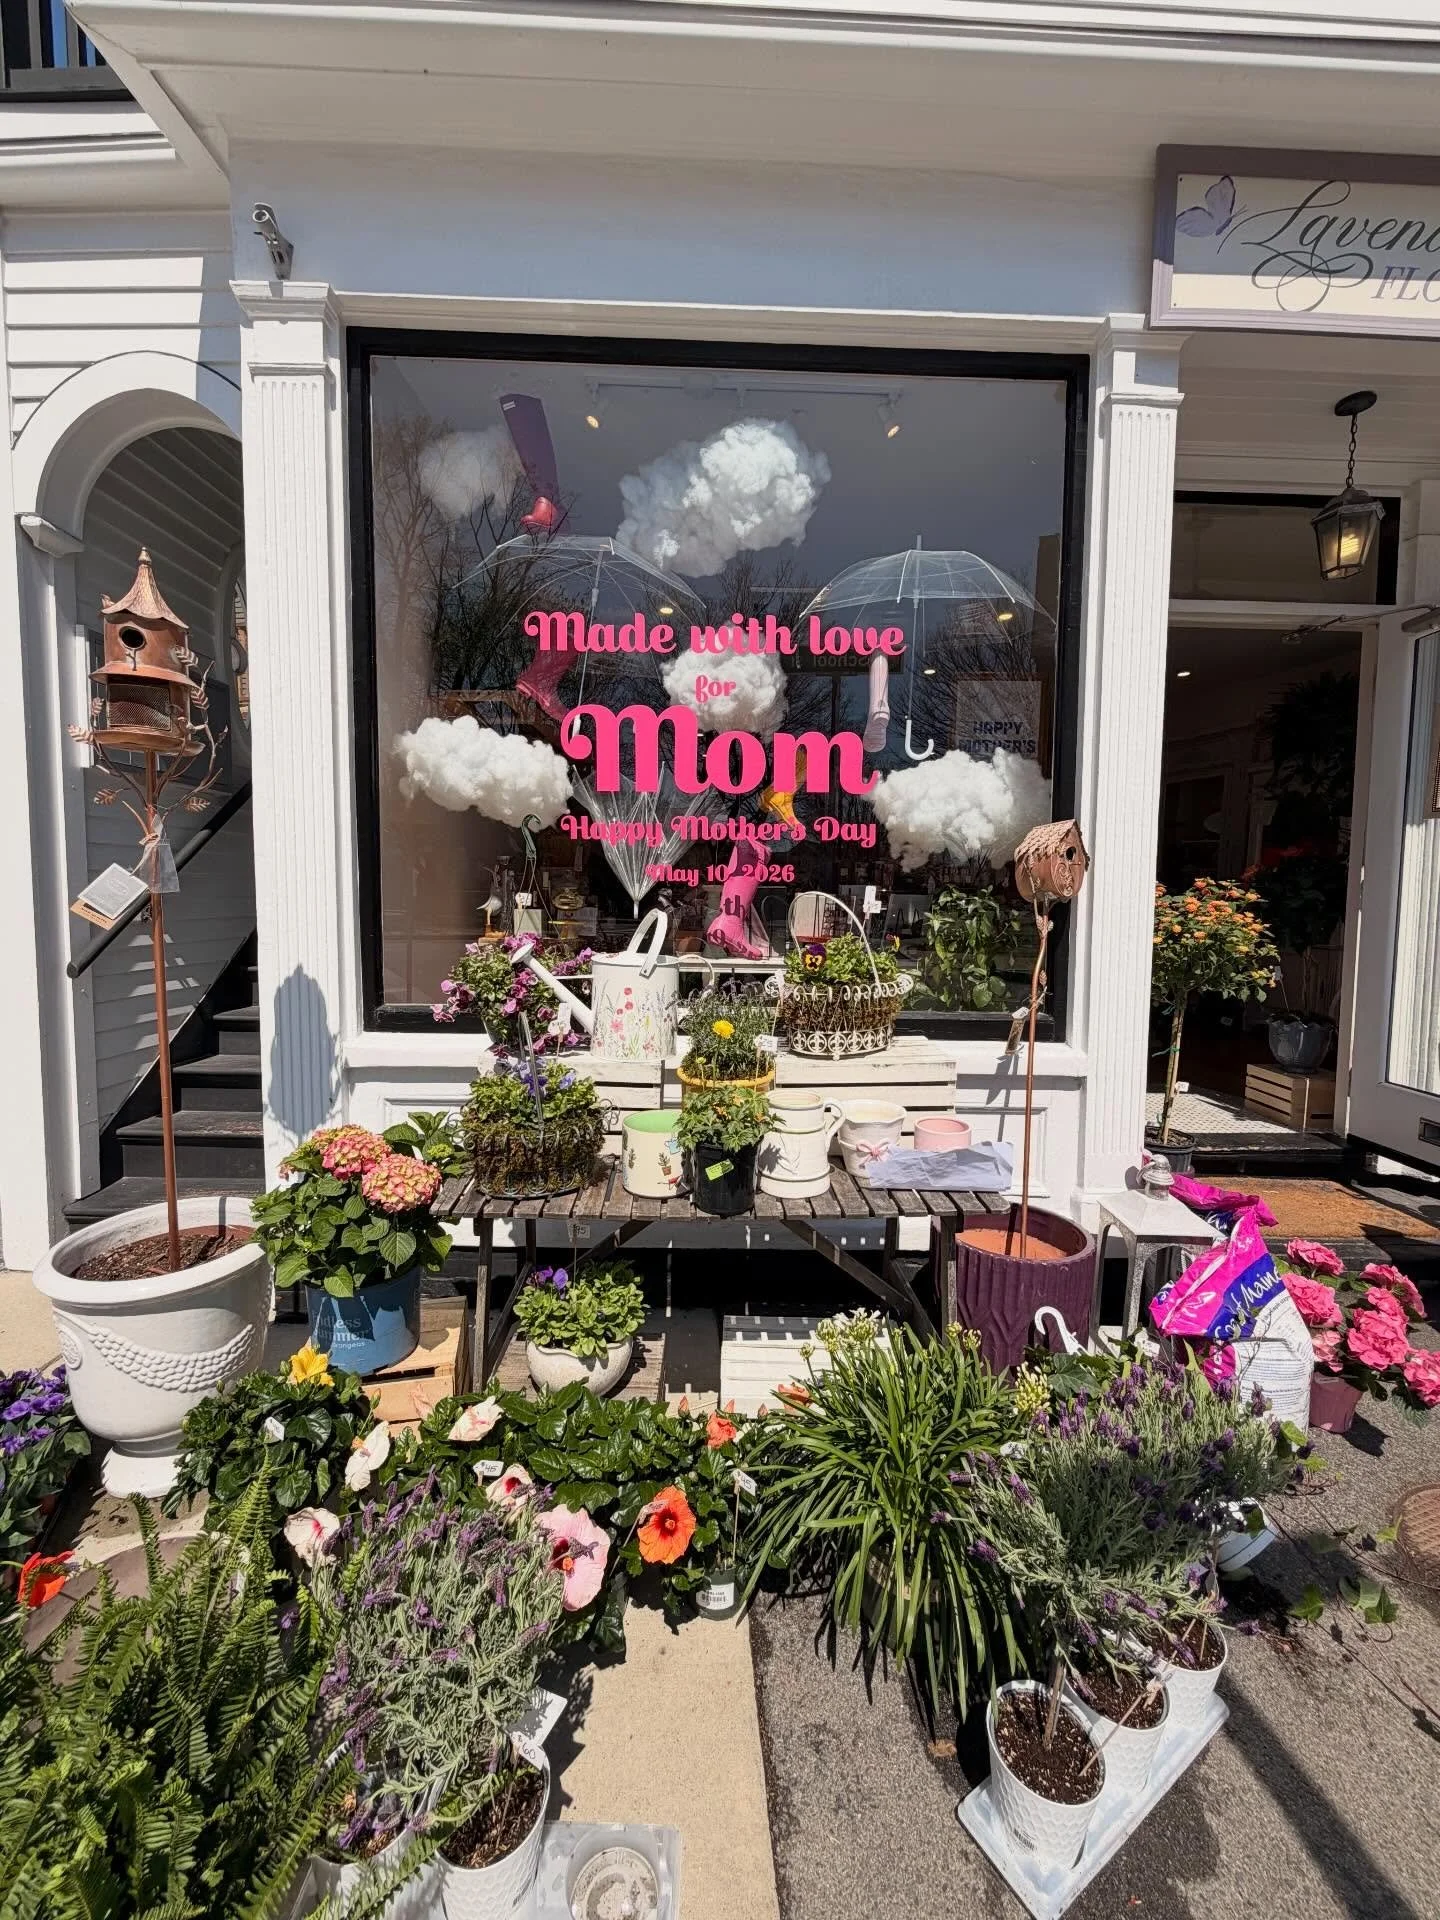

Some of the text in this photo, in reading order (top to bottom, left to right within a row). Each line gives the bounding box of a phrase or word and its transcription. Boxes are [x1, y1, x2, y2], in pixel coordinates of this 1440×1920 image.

[523, 611, 906, 656] Made with love
[695, 675, 737, 703] for
[973, 720, 1024, 735] HAPPY
[560, 703, 879, 795] Mom
[560, 815, 877, 849] Happy Mother's Day
[645, 863, 699, 887] May
[742, 863, 795, 882] 2026
